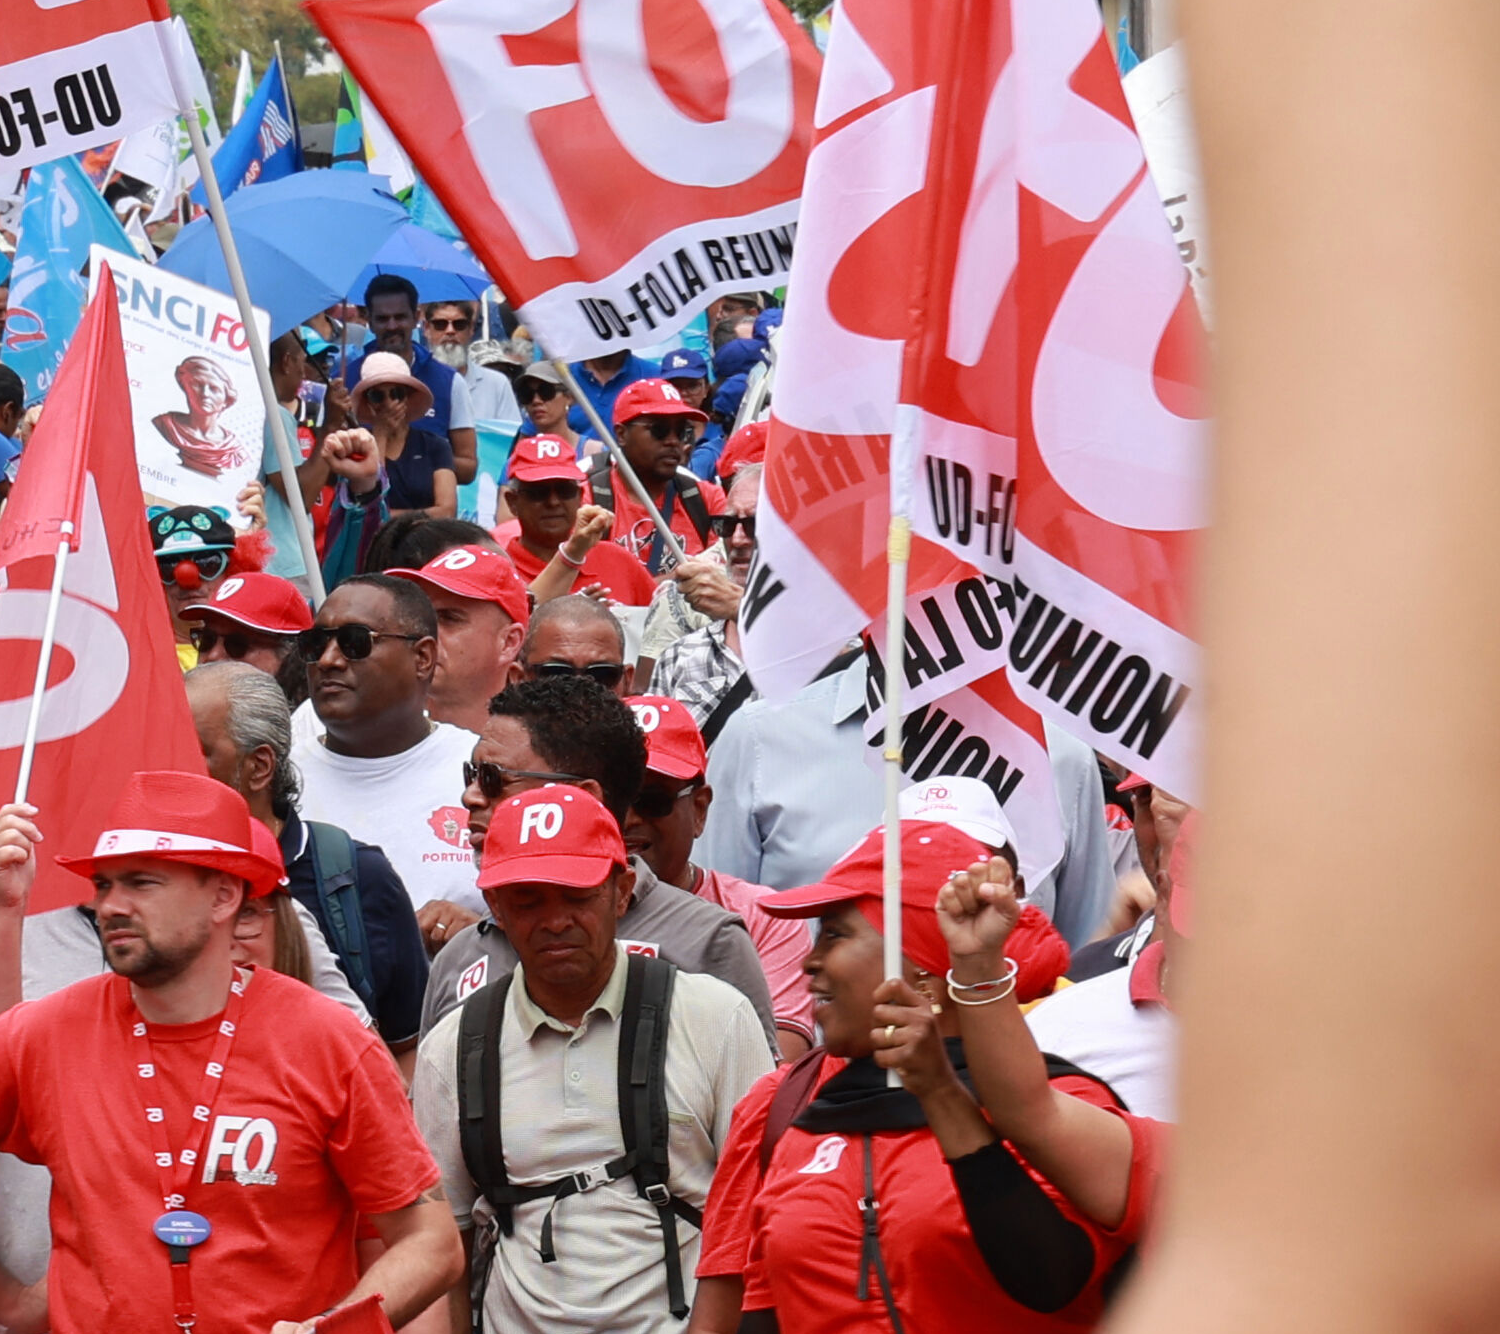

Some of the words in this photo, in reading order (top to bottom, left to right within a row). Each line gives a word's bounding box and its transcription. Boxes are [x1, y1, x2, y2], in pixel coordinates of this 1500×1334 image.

[113, 270, 206, 337] SNCI
[210, 313, 250, 352] FO
[576, 271, 677, 341] UD-FO
[658, 248, 708, 306] LA
[537, 440, 560, 458] FO
[137, 464, 178, 487] EMBRE
[432, 549, 476, 570] FO
[1008, 573, 1193, 761] UNION
[900, 703, 1025, 808] NION
[520, 803, 563, 844] FO
[423, 852, 475, 863] PORTUA
[459, 961, 485, 998] FO
[202, 1115, 279, 1185] FO
